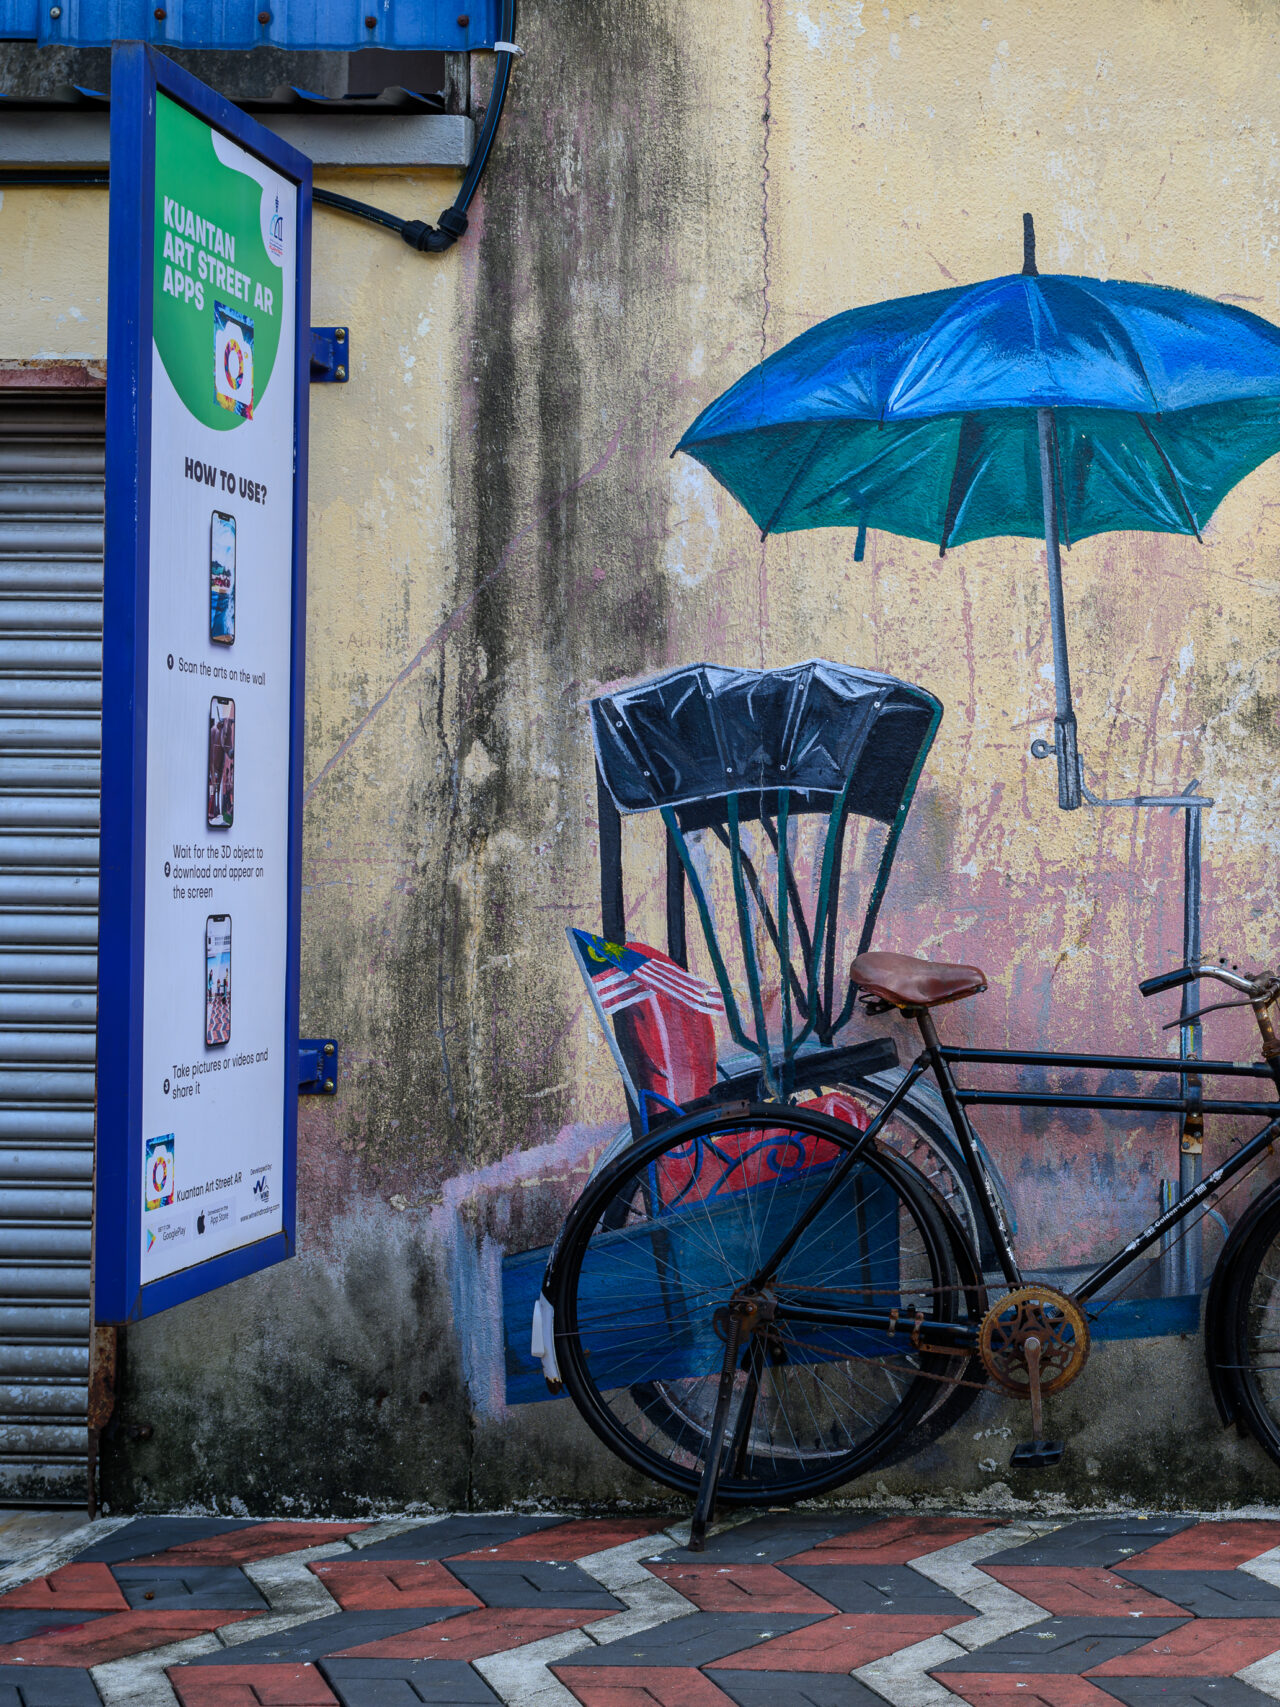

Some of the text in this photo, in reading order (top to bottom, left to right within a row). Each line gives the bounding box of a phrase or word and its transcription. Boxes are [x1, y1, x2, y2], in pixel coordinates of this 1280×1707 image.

[164, 196, 235, 263] KUANTAN
[163, 231, 273, 315] ART STREET AR
[163, 265, 204, 310] APPS
[185, 457, 267, 505] HOW TO USE?
[179, 658, 265, 685] Scan the arts on the wall
[173, 844, 263, 861] Wait for the 3D object to
[173, 866, 263, 881] download and appear on
[173, 886, 213, 899] the screen
[173, 1048, 268, 1079] Take pictures or videos and
[173, 1081, 200, 1099] share it
[177, 1171, 242, 1202] Kuantan Art Street AR
